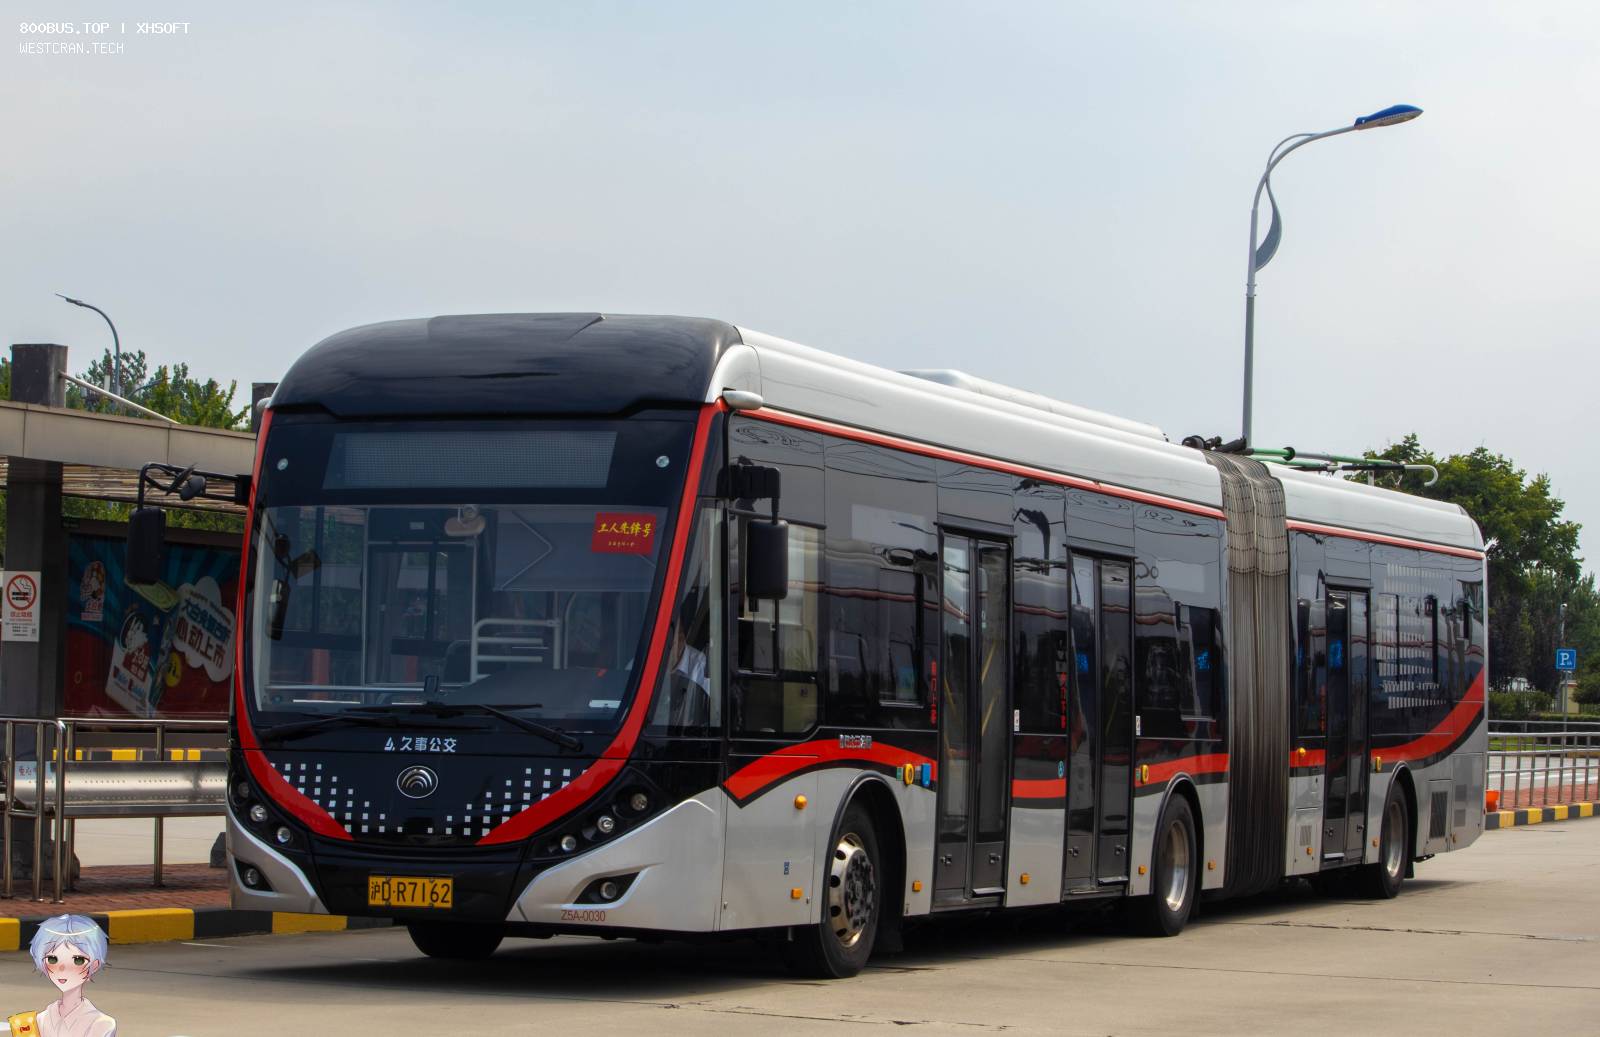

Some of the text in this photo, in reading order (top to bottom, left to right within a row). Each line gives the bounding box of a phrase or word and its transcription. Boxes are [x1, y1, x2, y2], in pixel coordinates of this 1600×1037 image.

[1559, 653, 1569, 666] P
[400, 737, 457, 753] 久事公交
[561, 909, 606, 922] Z5A-0030
